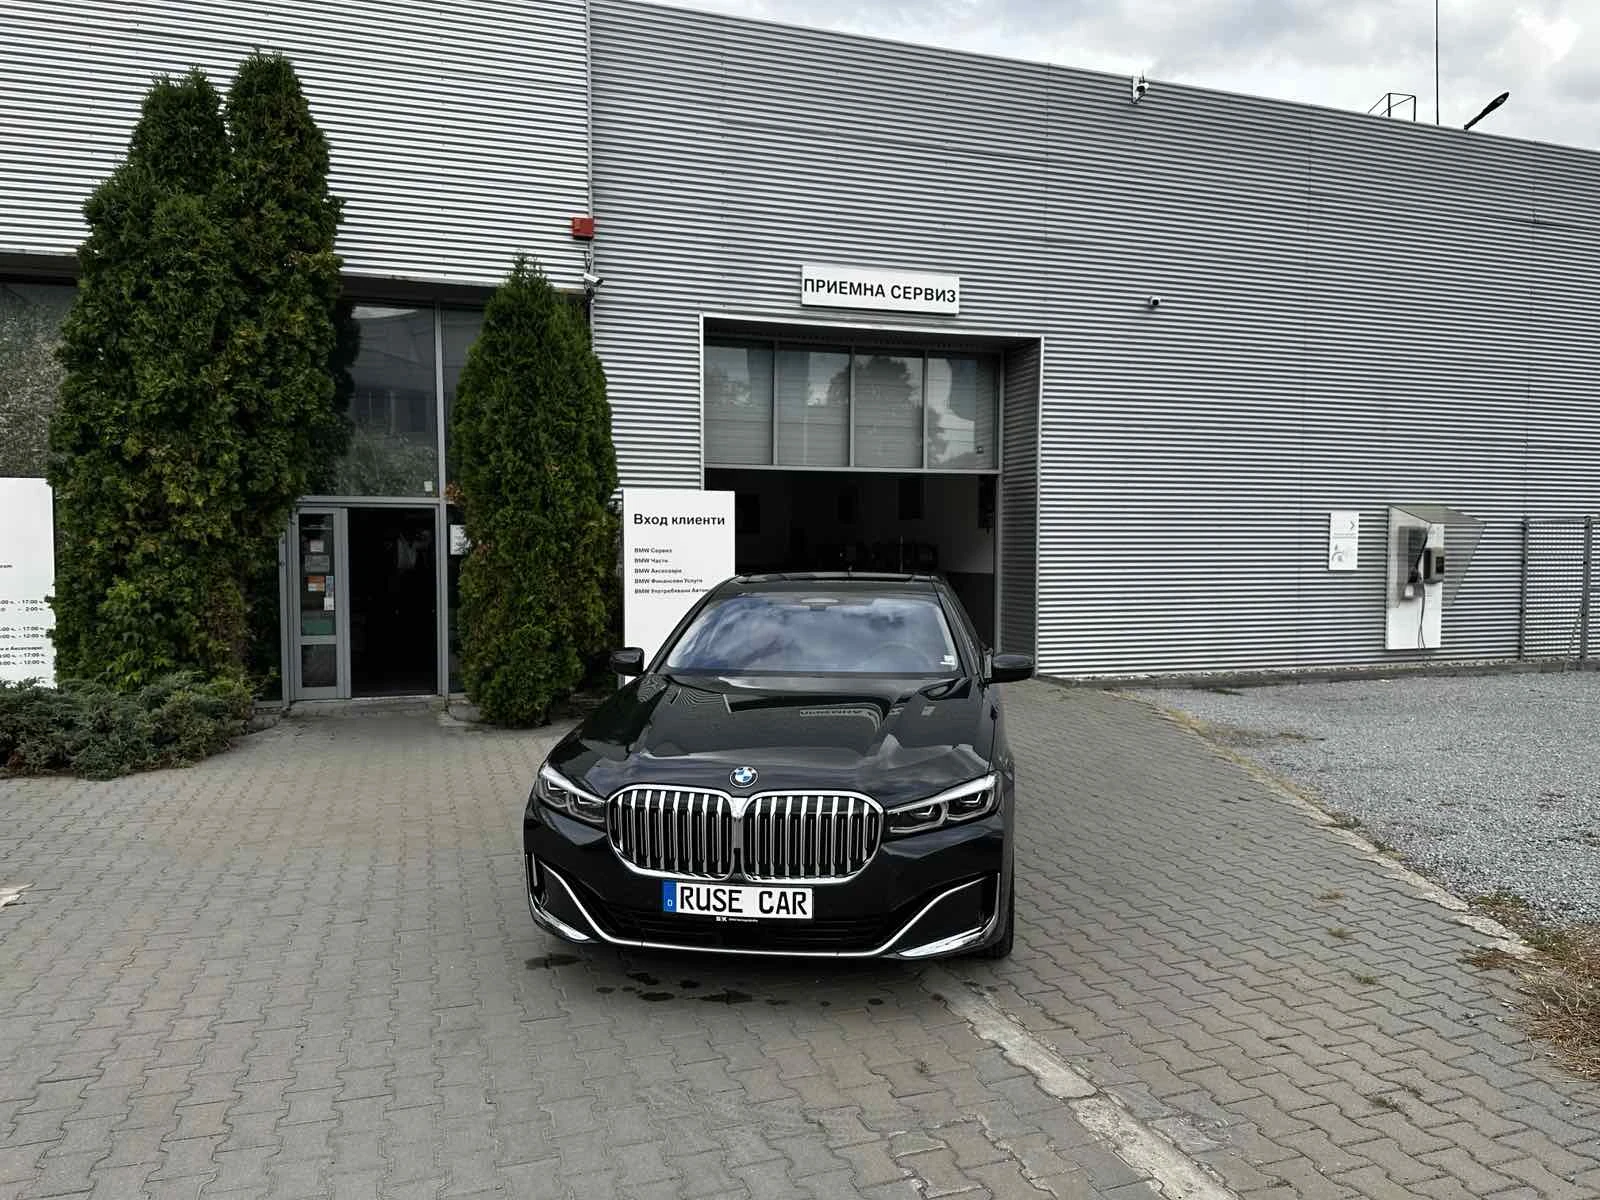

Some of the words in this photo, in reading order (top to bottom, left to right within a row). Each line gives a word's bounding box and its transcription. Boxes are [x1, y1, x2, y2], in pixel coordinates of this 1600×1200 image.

[804, 278, 886, 298] ПРИЕМНА
[890, 284, 956, 303] СЕРВИЗ
[633, 513, 669, 527] Вход
[671, 515, 725, 526] клиенти
[680, 886, 744, 914] RUSE
[759, 890, 807, 916] CAR
